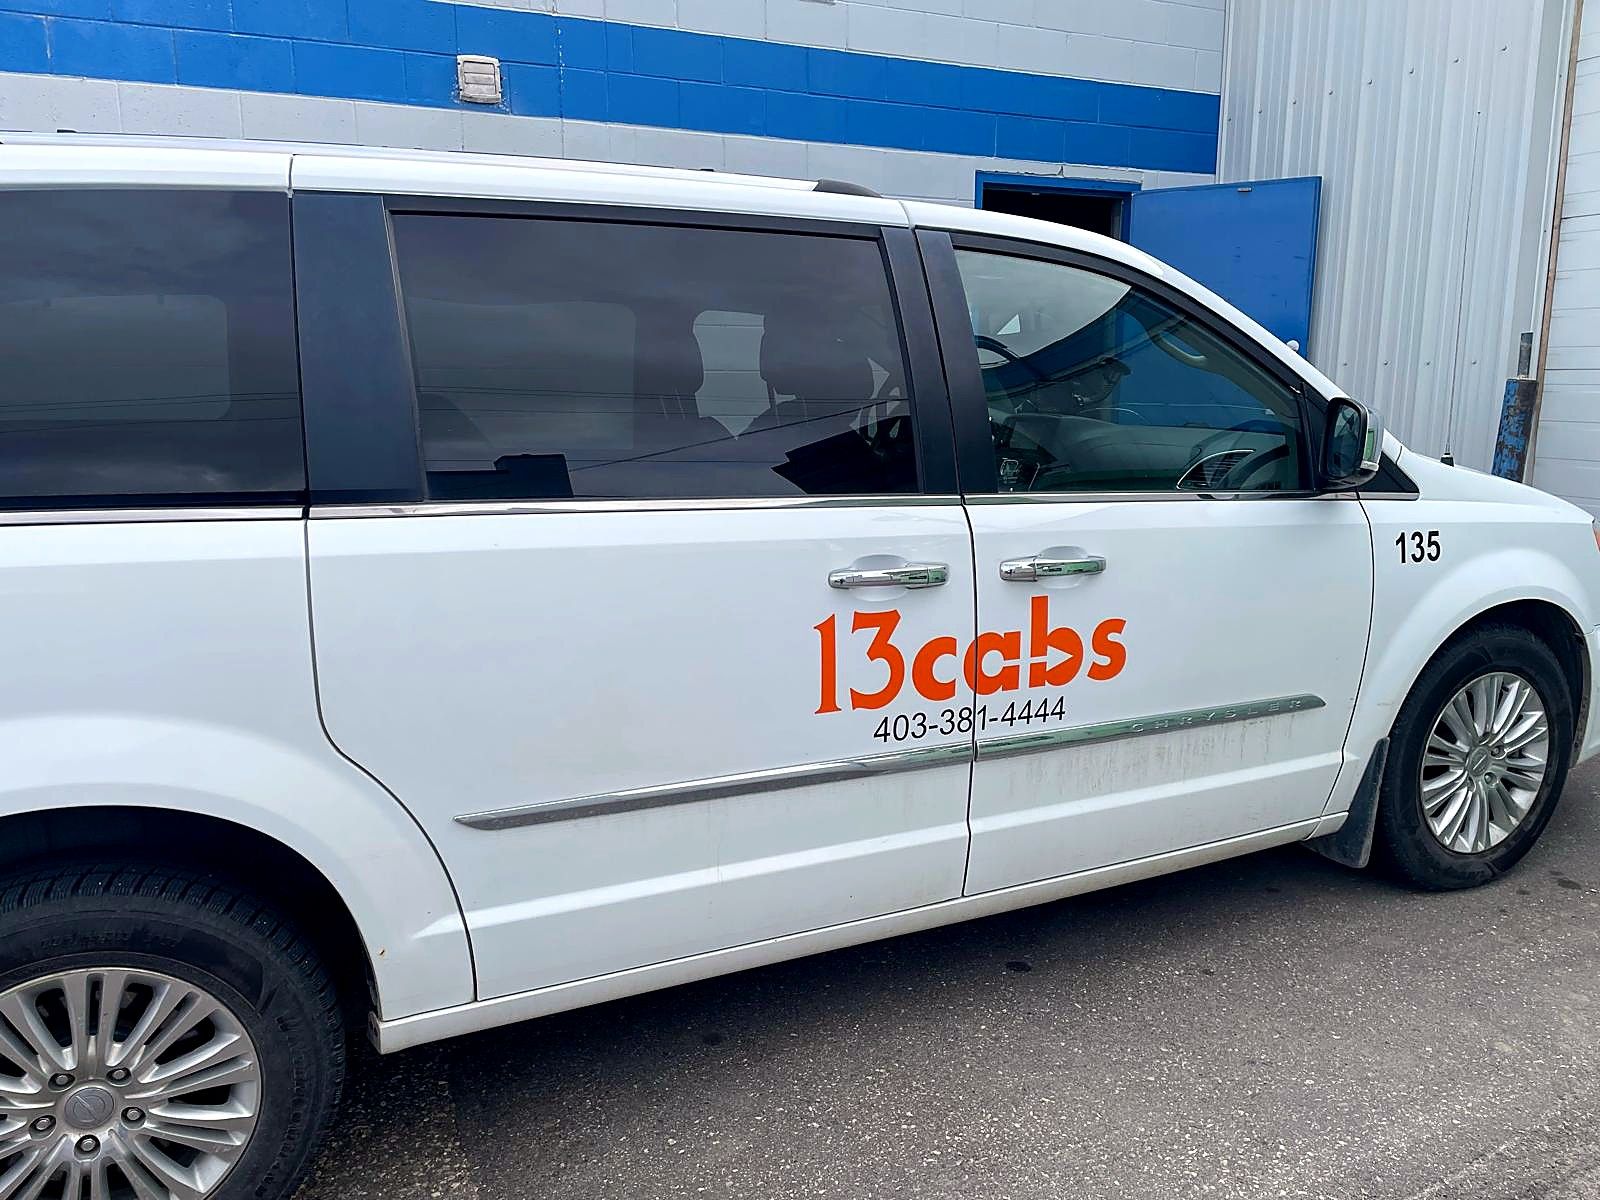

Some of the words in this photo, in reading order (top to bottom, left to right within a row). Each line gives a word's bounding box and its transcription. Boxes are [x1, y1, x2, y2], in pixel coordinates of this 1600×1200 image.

[1395, 530, 1441, 564] 135
[814, 596, 1127, 714] 13cabs
[873, 695, 1066, 743] 403-381-4444
[1132, 700, 1302, 733] CHRYSLER
